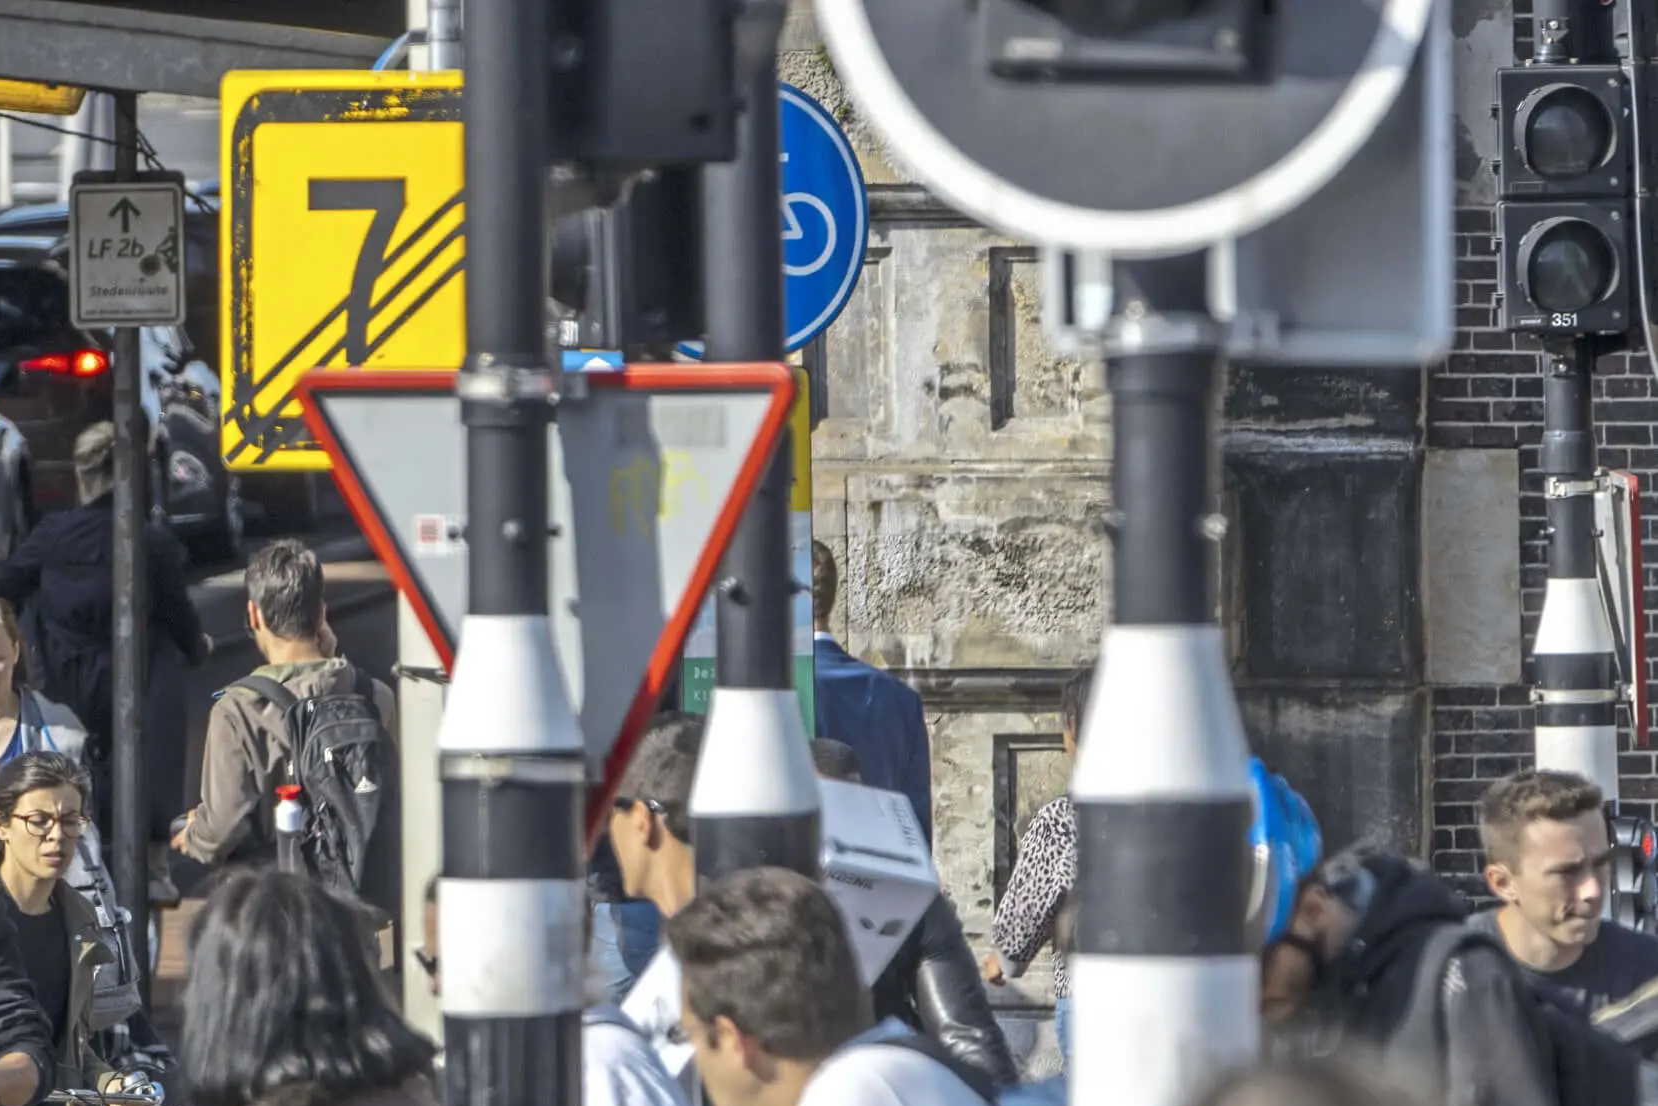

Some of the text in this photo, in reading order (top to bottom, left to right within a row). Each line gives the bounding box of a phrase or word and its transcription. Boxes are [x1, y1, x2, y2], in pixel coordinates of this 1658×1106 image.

[87, 238, 145, 259] LF 2b
[308, 177, 407, 366] 7
[1551, 312, 1578, 327] 351
